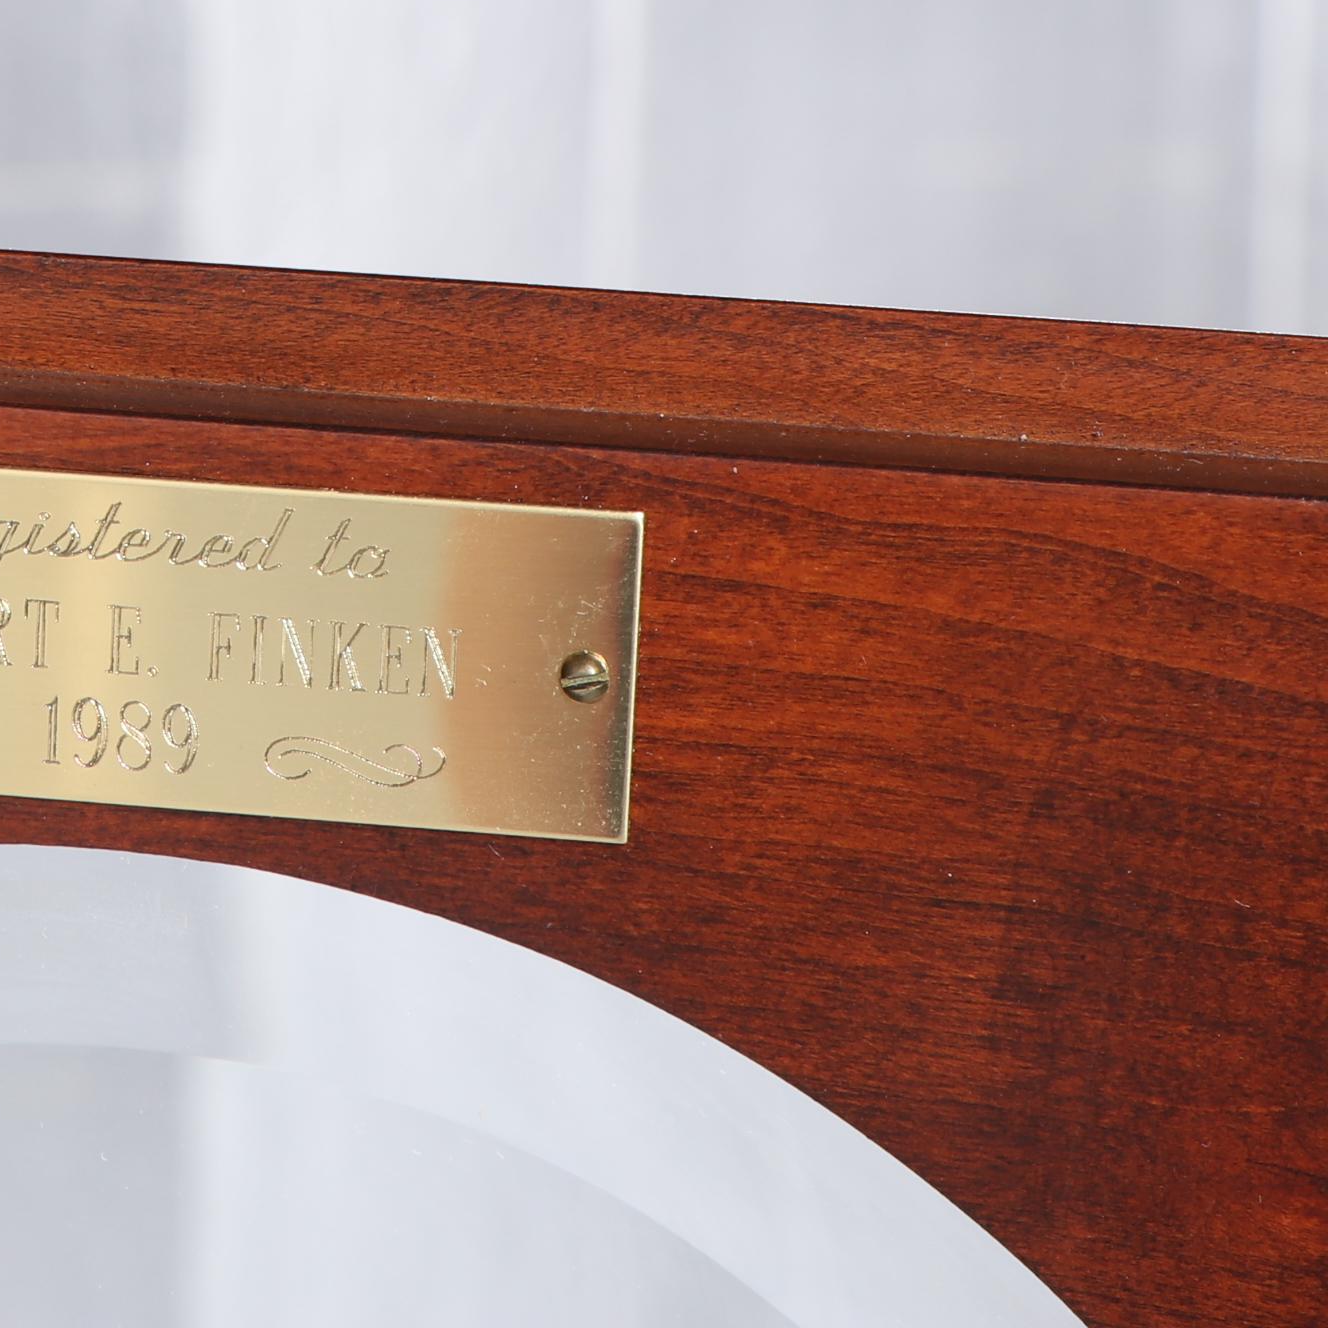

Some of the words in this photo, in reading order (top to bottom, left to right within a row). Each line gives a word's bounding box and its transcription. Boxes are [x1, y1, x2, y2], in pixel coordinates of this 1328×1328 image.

[311, 517, 390, 578] to
[107, 604, 159, 677] E.
[206, 612, 463, 699] FINKEN
[43, 695, 199, 774] 1989
